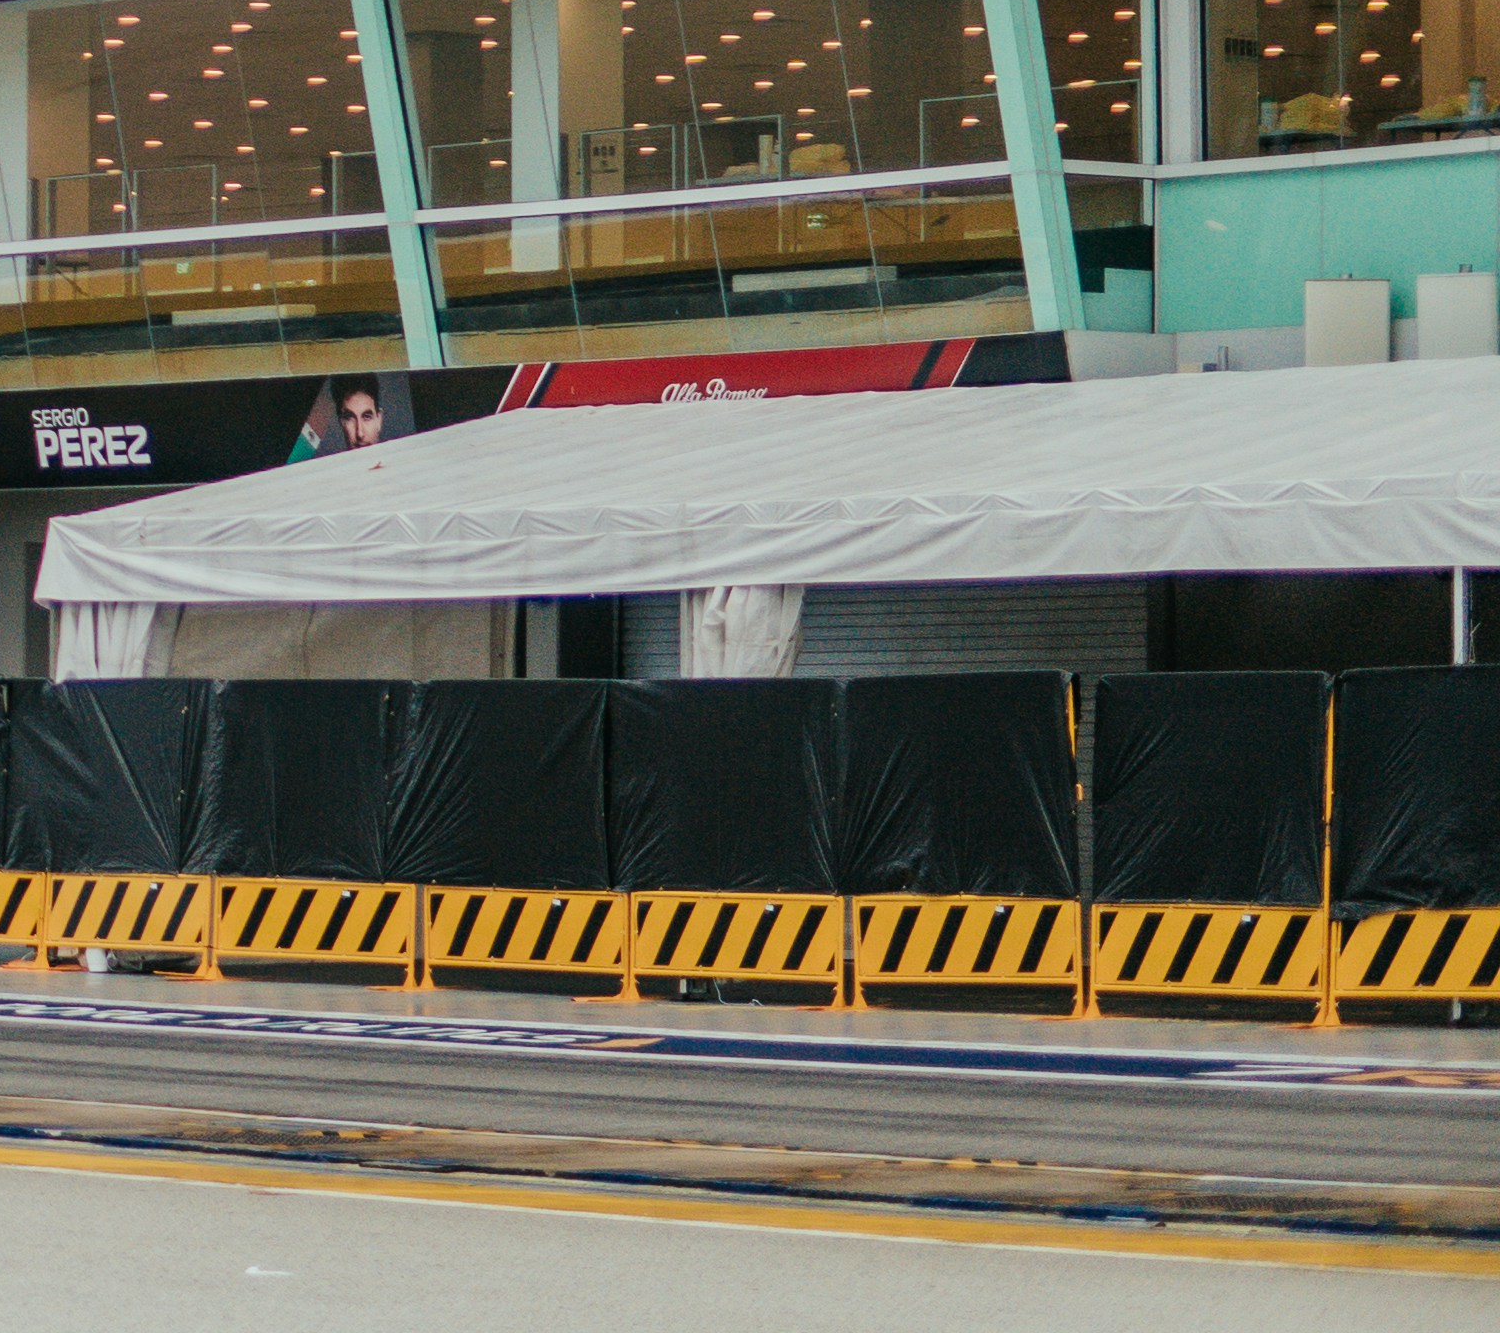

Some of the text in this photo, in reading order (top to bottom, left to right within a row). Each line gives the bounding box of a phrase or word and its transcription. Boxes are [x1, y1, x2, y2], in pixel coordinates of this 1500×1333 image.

[661, 378, 768, 403] Alfa Romeo
[31, 407, 90, 428] SERGIO
[35, 425, 151, 469] PEREZ
